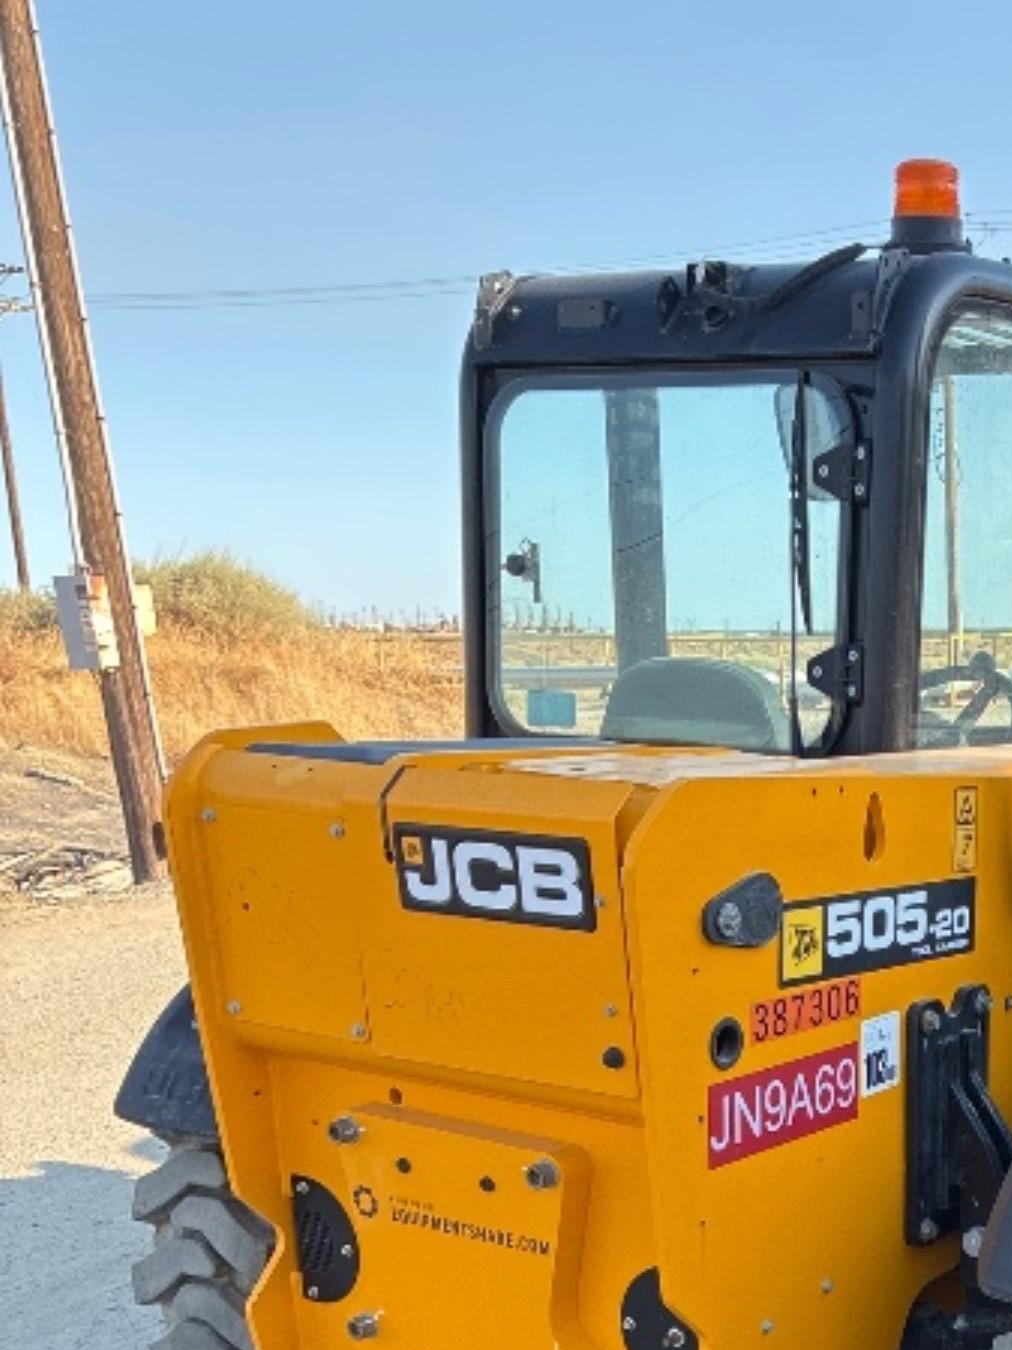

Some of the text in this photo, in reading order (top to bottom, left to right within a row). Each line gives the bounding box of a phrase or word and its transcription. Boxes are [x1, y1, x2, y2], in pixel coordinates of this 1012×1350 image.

[404, 838, 584, 916] JCB
[753, 979, 860, 1042] 387306
[710, 1058, 855, 1151] JN9A69
